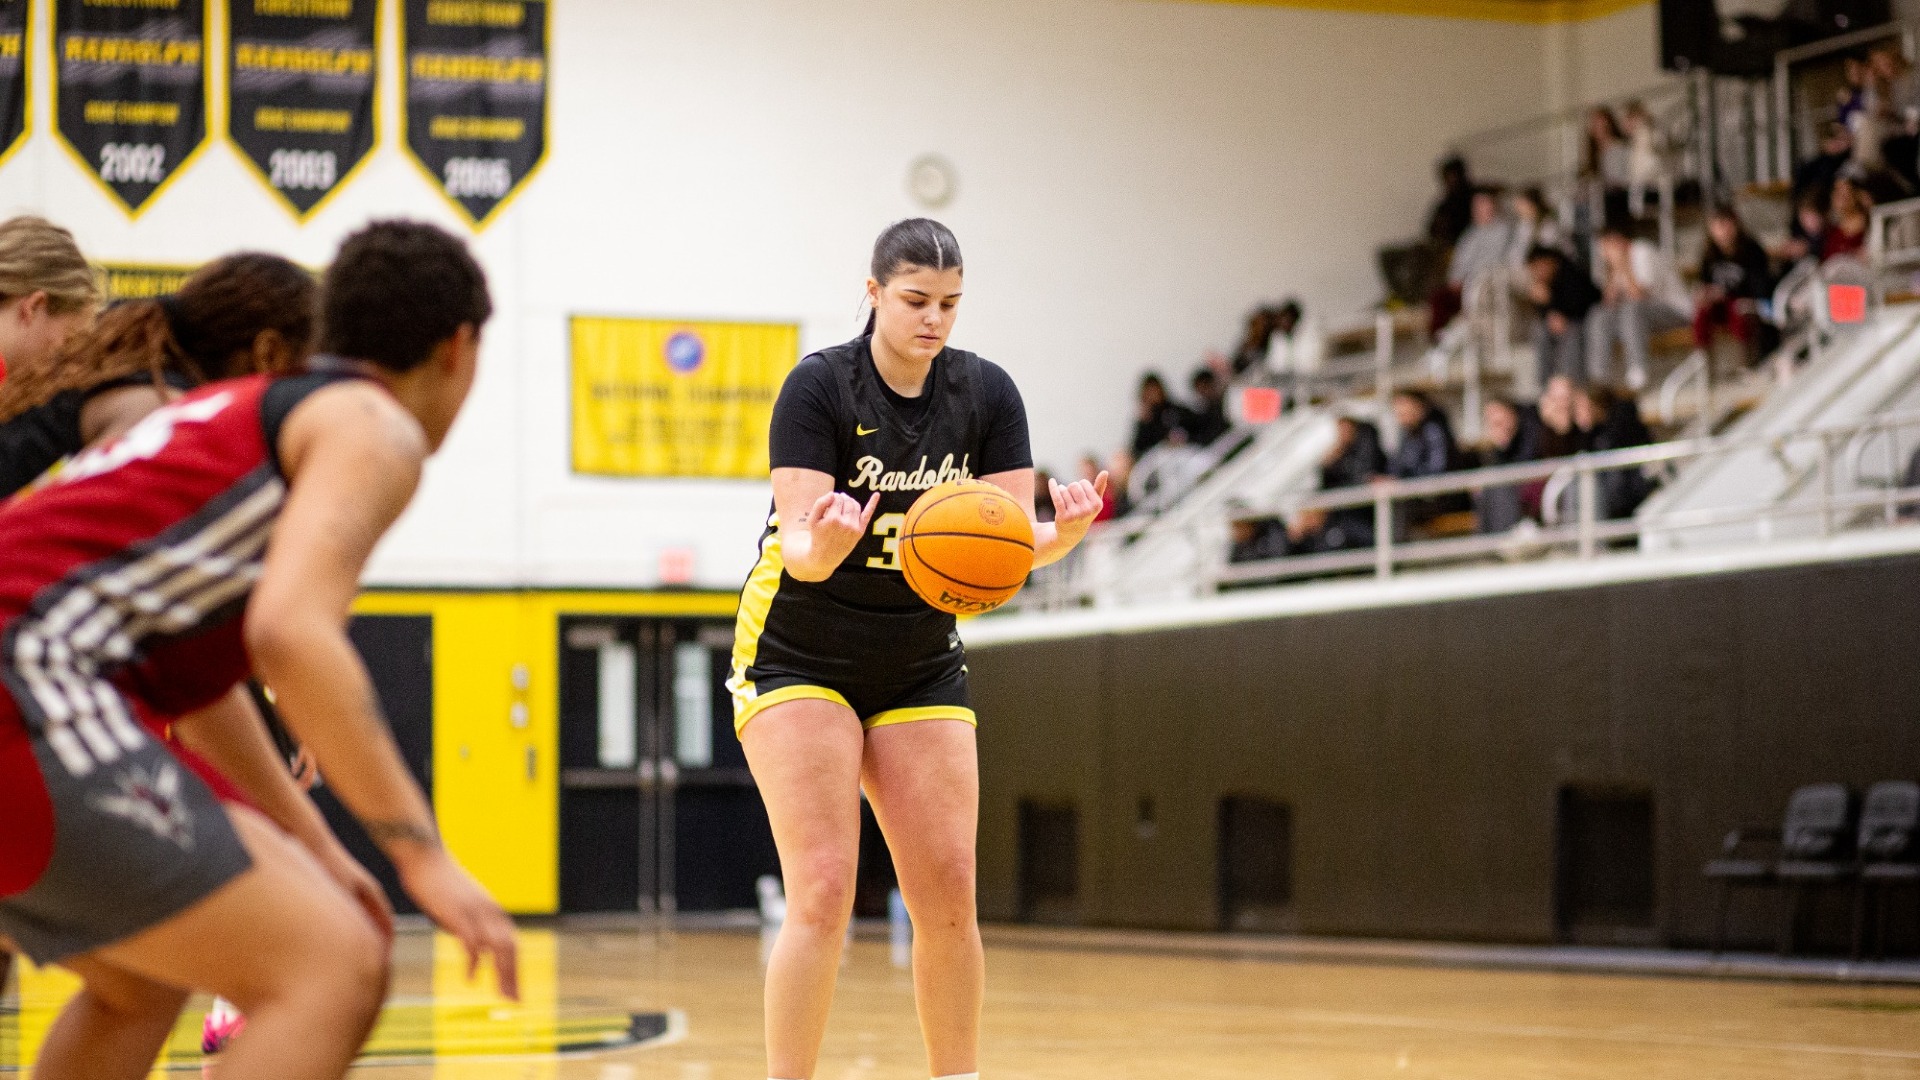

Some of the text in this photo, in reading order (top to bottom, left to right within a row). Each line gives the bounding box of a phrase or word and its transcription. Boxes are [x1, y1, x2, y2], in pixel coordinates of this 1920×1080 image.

[65, 36, 200, 66] RANDOLPH
[236, 44, 372, 74] RANDOLPH
[411, 54, 543, 83] RANDOLPH
[100, 142, 166, 183] 2002
[269, 148, 337, 190] 2003
